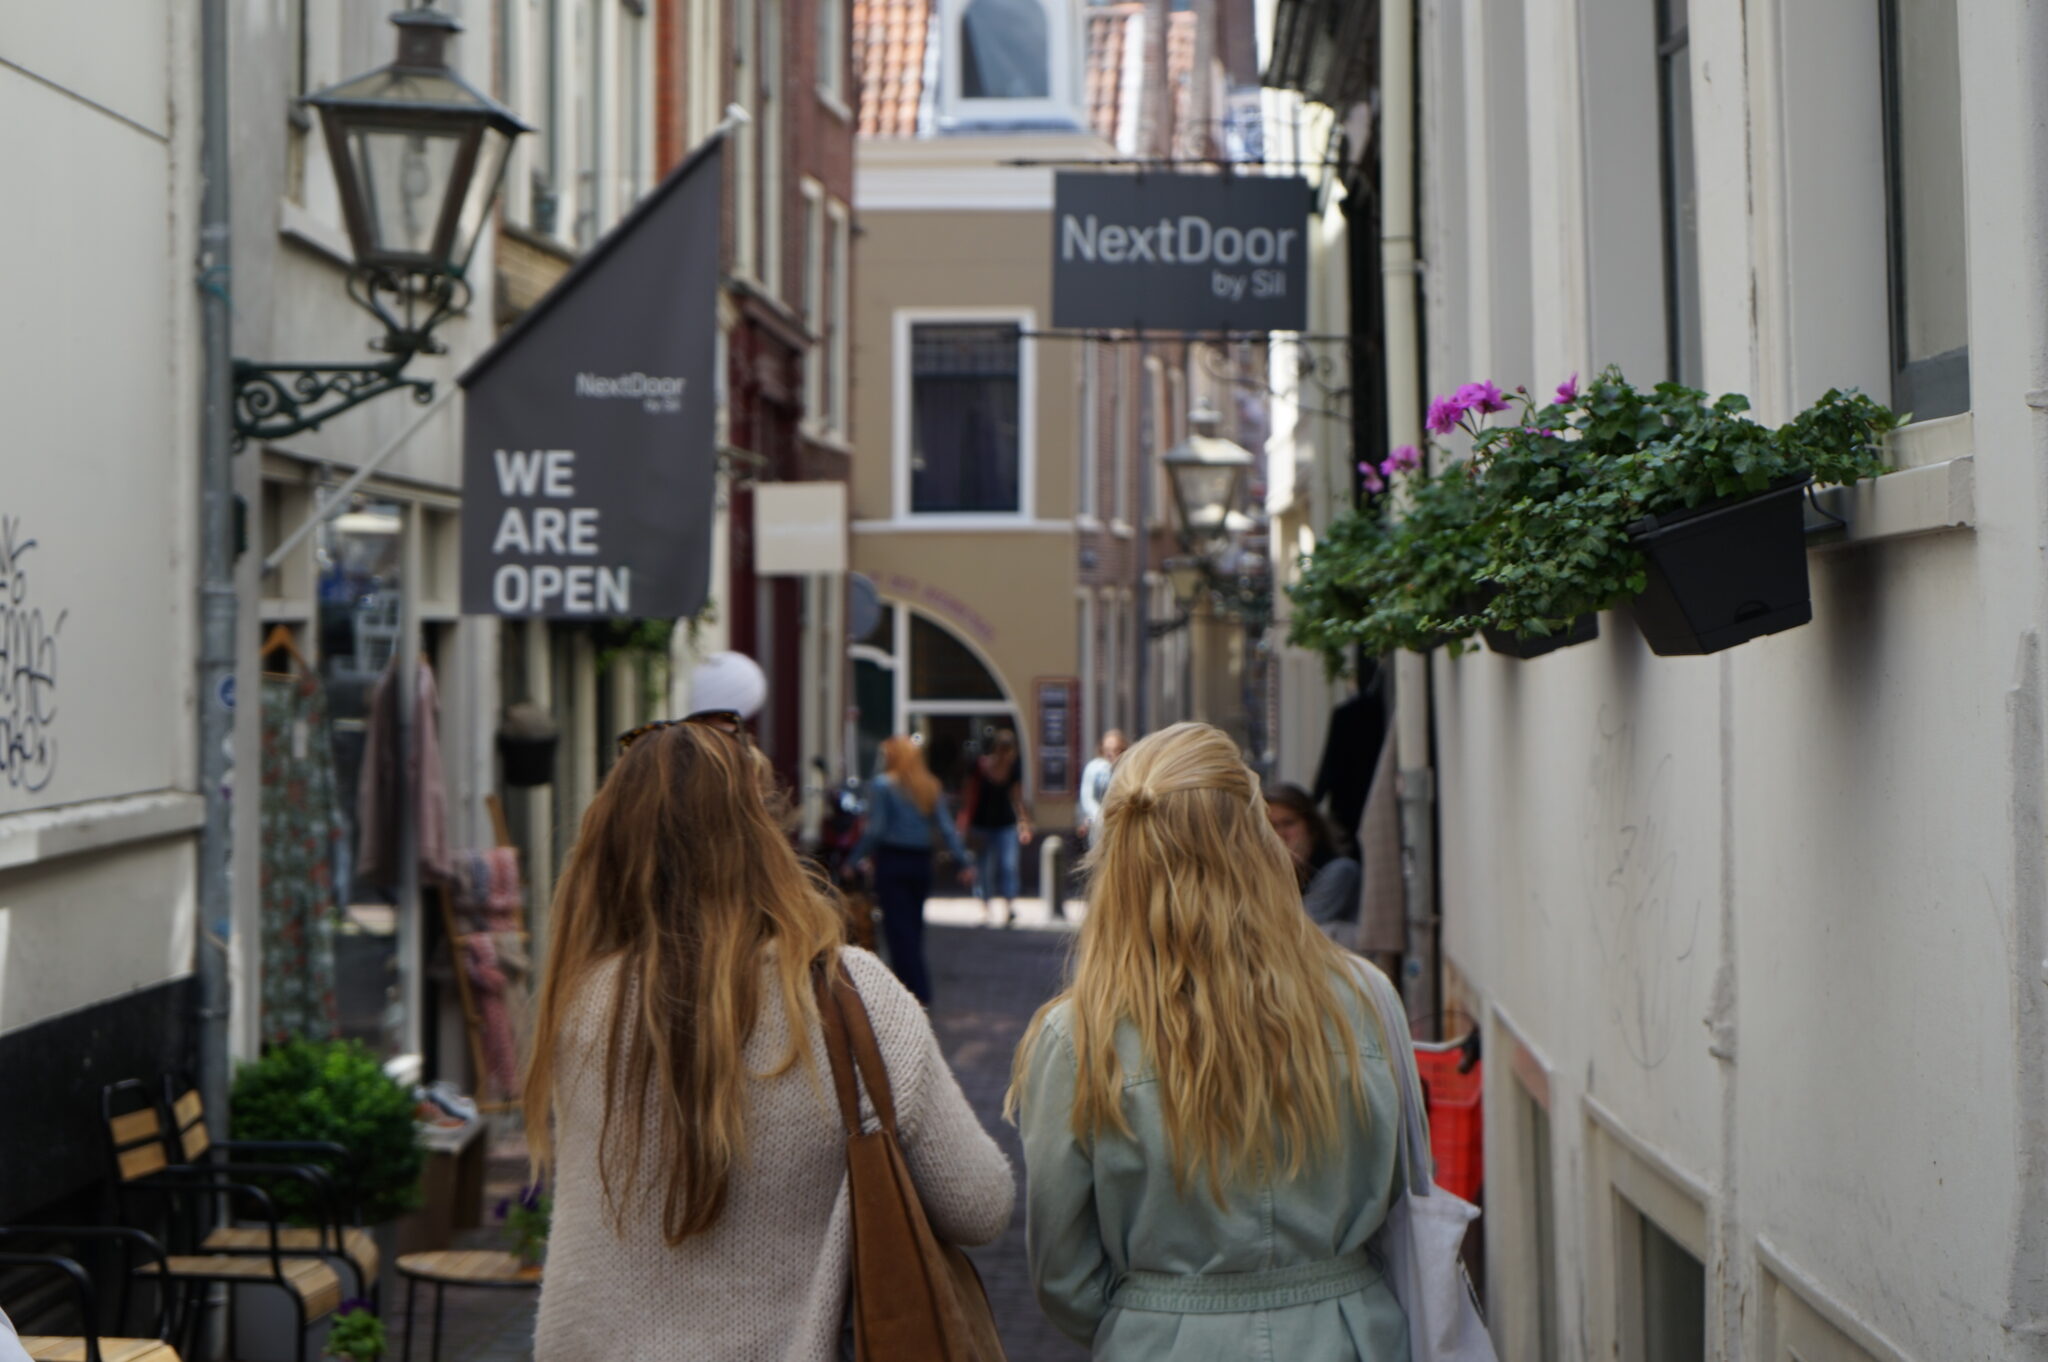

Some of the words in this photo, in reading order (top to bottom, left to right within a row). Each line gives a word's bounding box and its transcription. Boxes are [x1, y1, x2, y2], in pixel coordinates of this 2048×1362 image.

[1062, 214, 1296, 264] NextDoor
[1212, 269, 1247, 302] by
[1252, 269, 1287, 298] Sil
[576, 371, 686, 398] NextDoor
[494, 449, 575, 497] WE
[492, 507, 600, 555] ARE
[493, 564, 630, 613] OPEN
